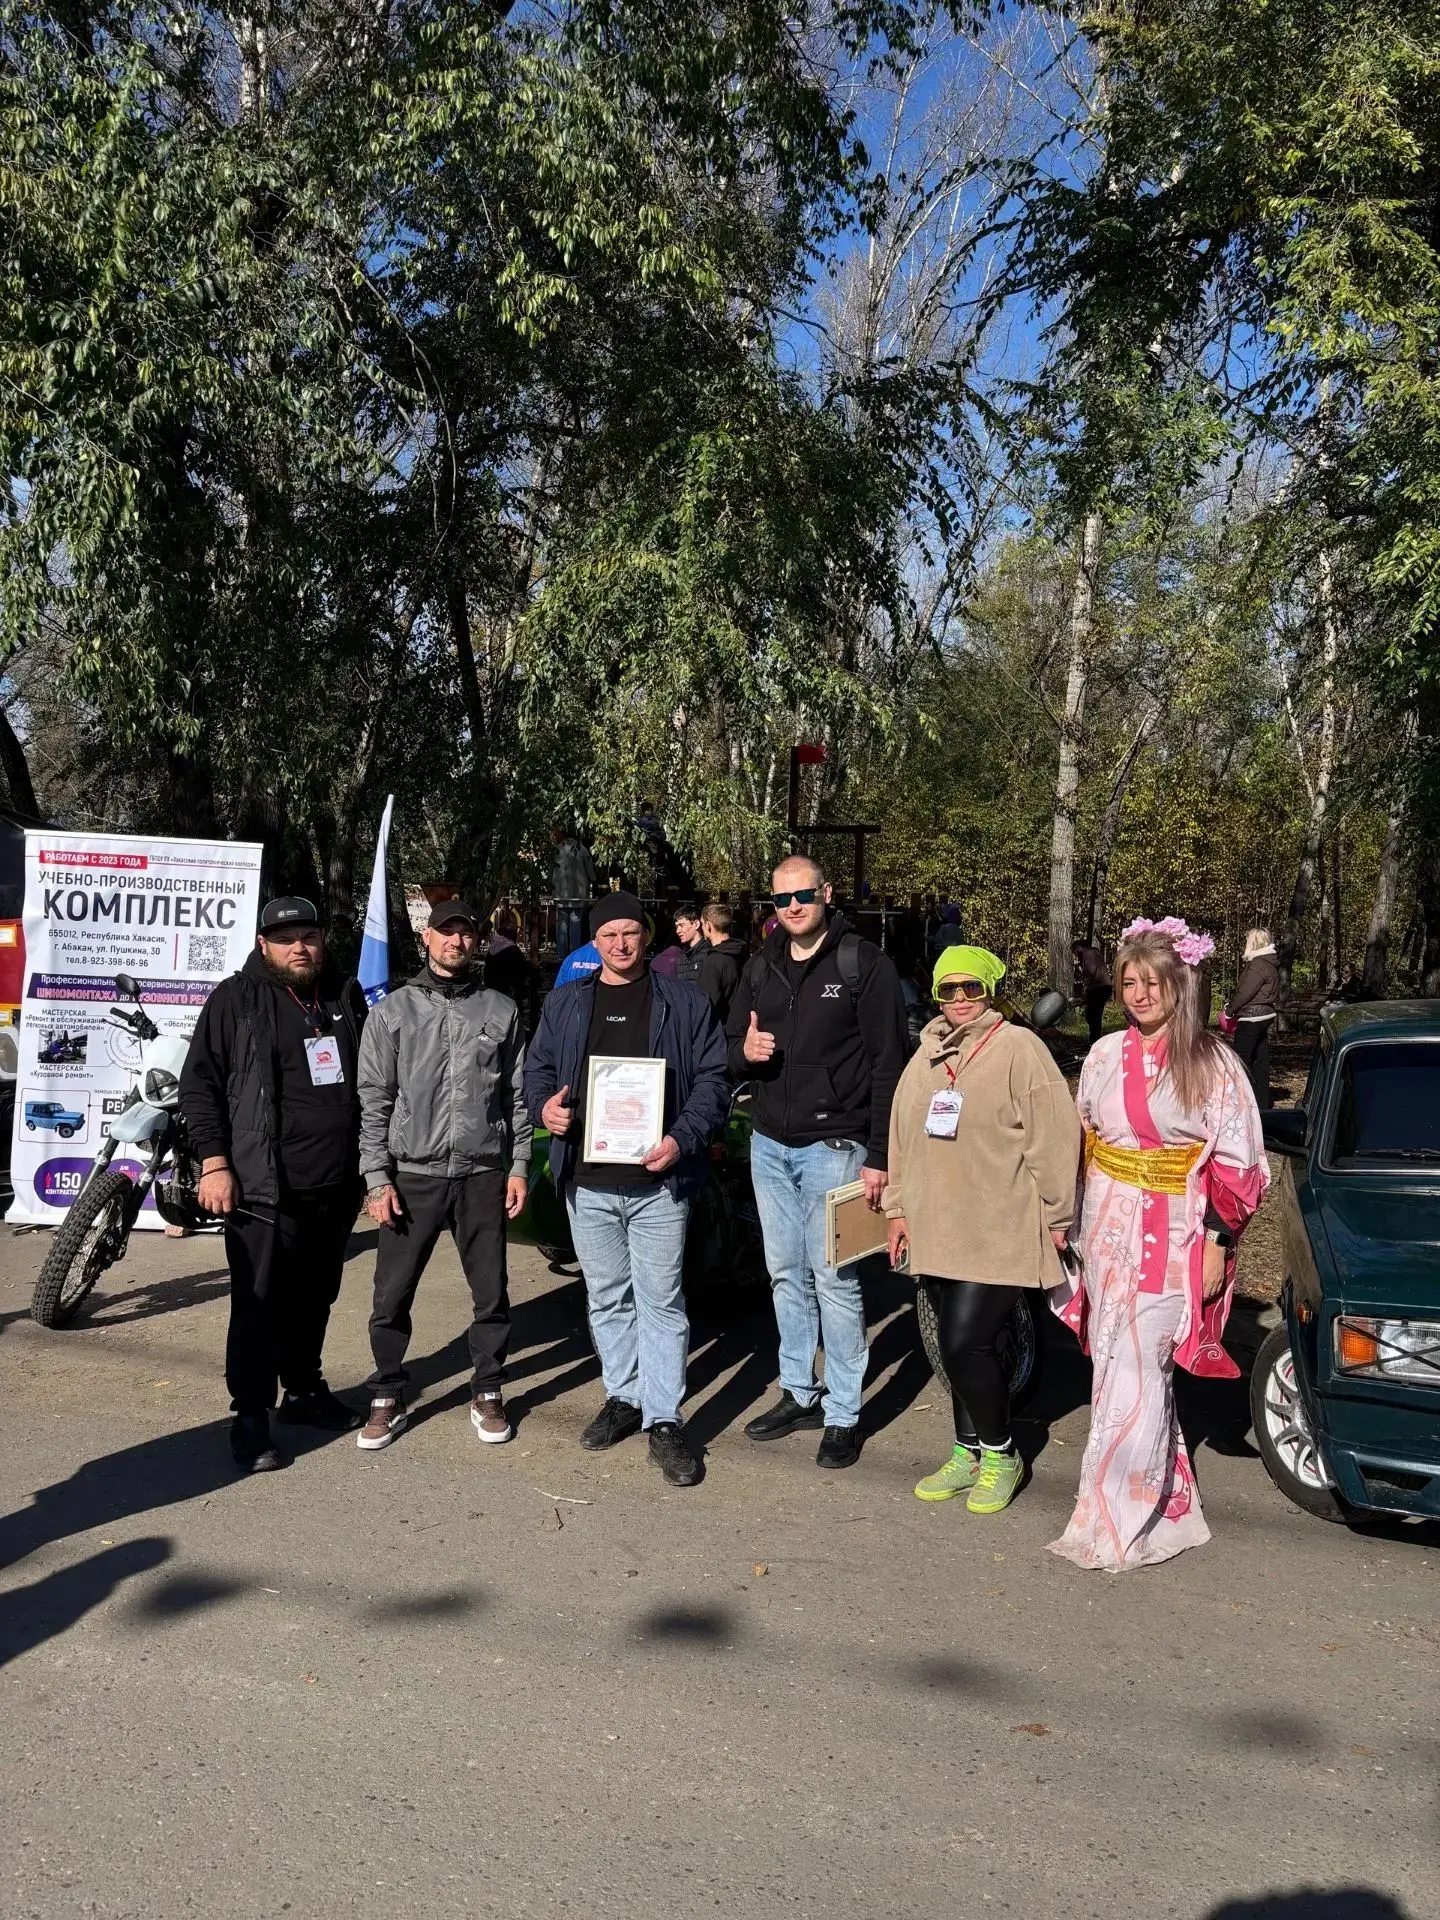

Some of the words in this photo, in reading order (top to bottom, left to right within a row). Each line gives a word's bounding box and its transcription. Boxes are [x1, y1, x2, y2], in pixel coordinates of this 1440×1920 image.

[45, 852, 89, 863] РАБОТАЕМ
[91, 855, 97, 864] С
[99, 856, 118, 865] 2023
[120, 857, 141, 867] ГОДА
[38, 870, 246, 895] УЧЕБНО-ПРОИЗВОДСТВЕННЫЙ
[43, 889, 237, 930] КОМПЛЕКС
[48, 928, 79, 940] 655012,
[81, 931, 130, 942] Республика
[132, 934, 167, 944] Хакасия,
[61, 943, 94, 953] Абакан,
[96, 946, 107, 955] ул.
[110, 945, 149, 956] Пушкина,
[150, 947, 161, 956] 30
[186, 983, 212, 992] услуги
[36, 987, 118, 1001] ШИНОМОНТАЖА
[119, 994, 130, 1002] до
[132, 992, 188, 1004] УЗОВНОГО
[41, 1008, 87, 1016] МАСТЕРСКАЯ
[39, 1064, 84, 1072] МАСТЕРСКАЯ
[54, 1172, 82, 1189] 150
